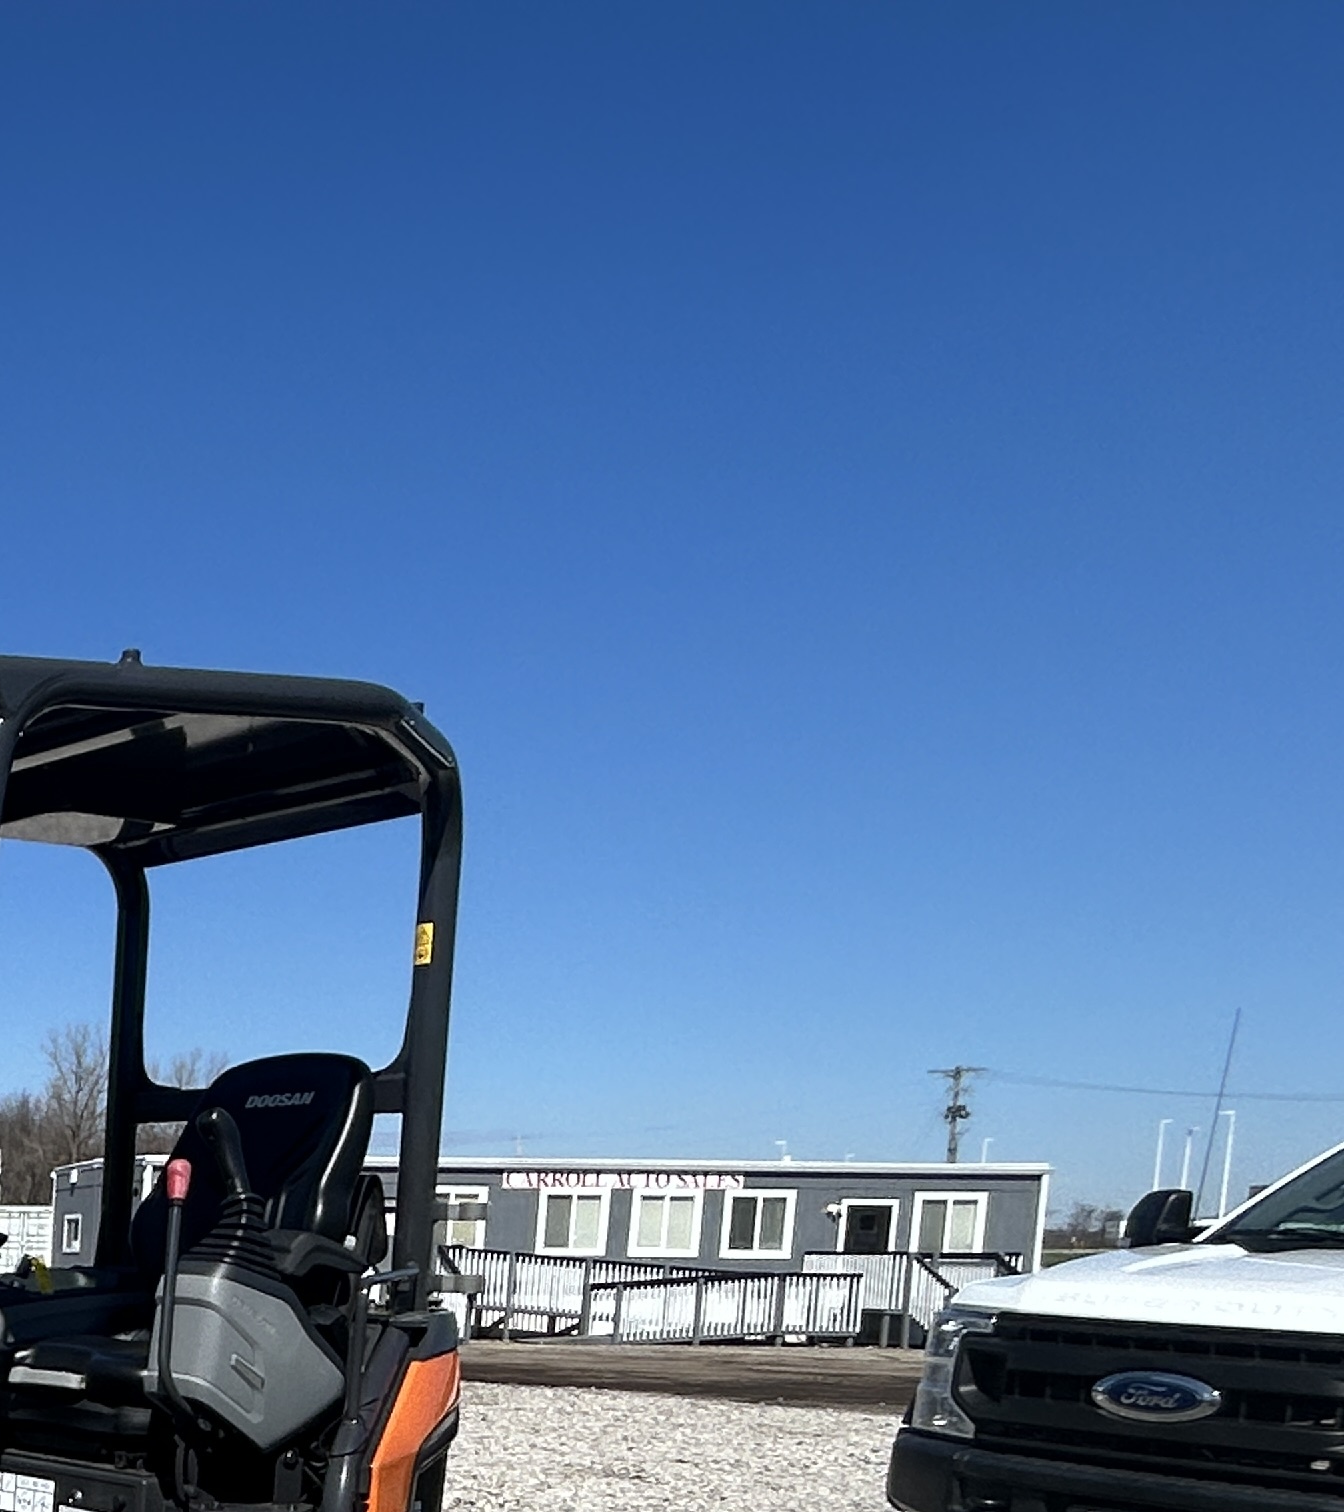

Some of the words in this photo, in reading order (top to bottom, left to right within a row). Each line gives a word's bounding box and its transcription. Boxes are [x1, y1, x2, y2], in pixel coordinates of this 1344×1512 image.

[244, 1091, 315, 1108] DOOSAN
[505, 1172, 610, 1189] CARROLL
[613, 1173, 671, 1189] AUTO
[675, 1174, 743, 1190] SALES
[1120, 1382, 1181, 1408] Ford
